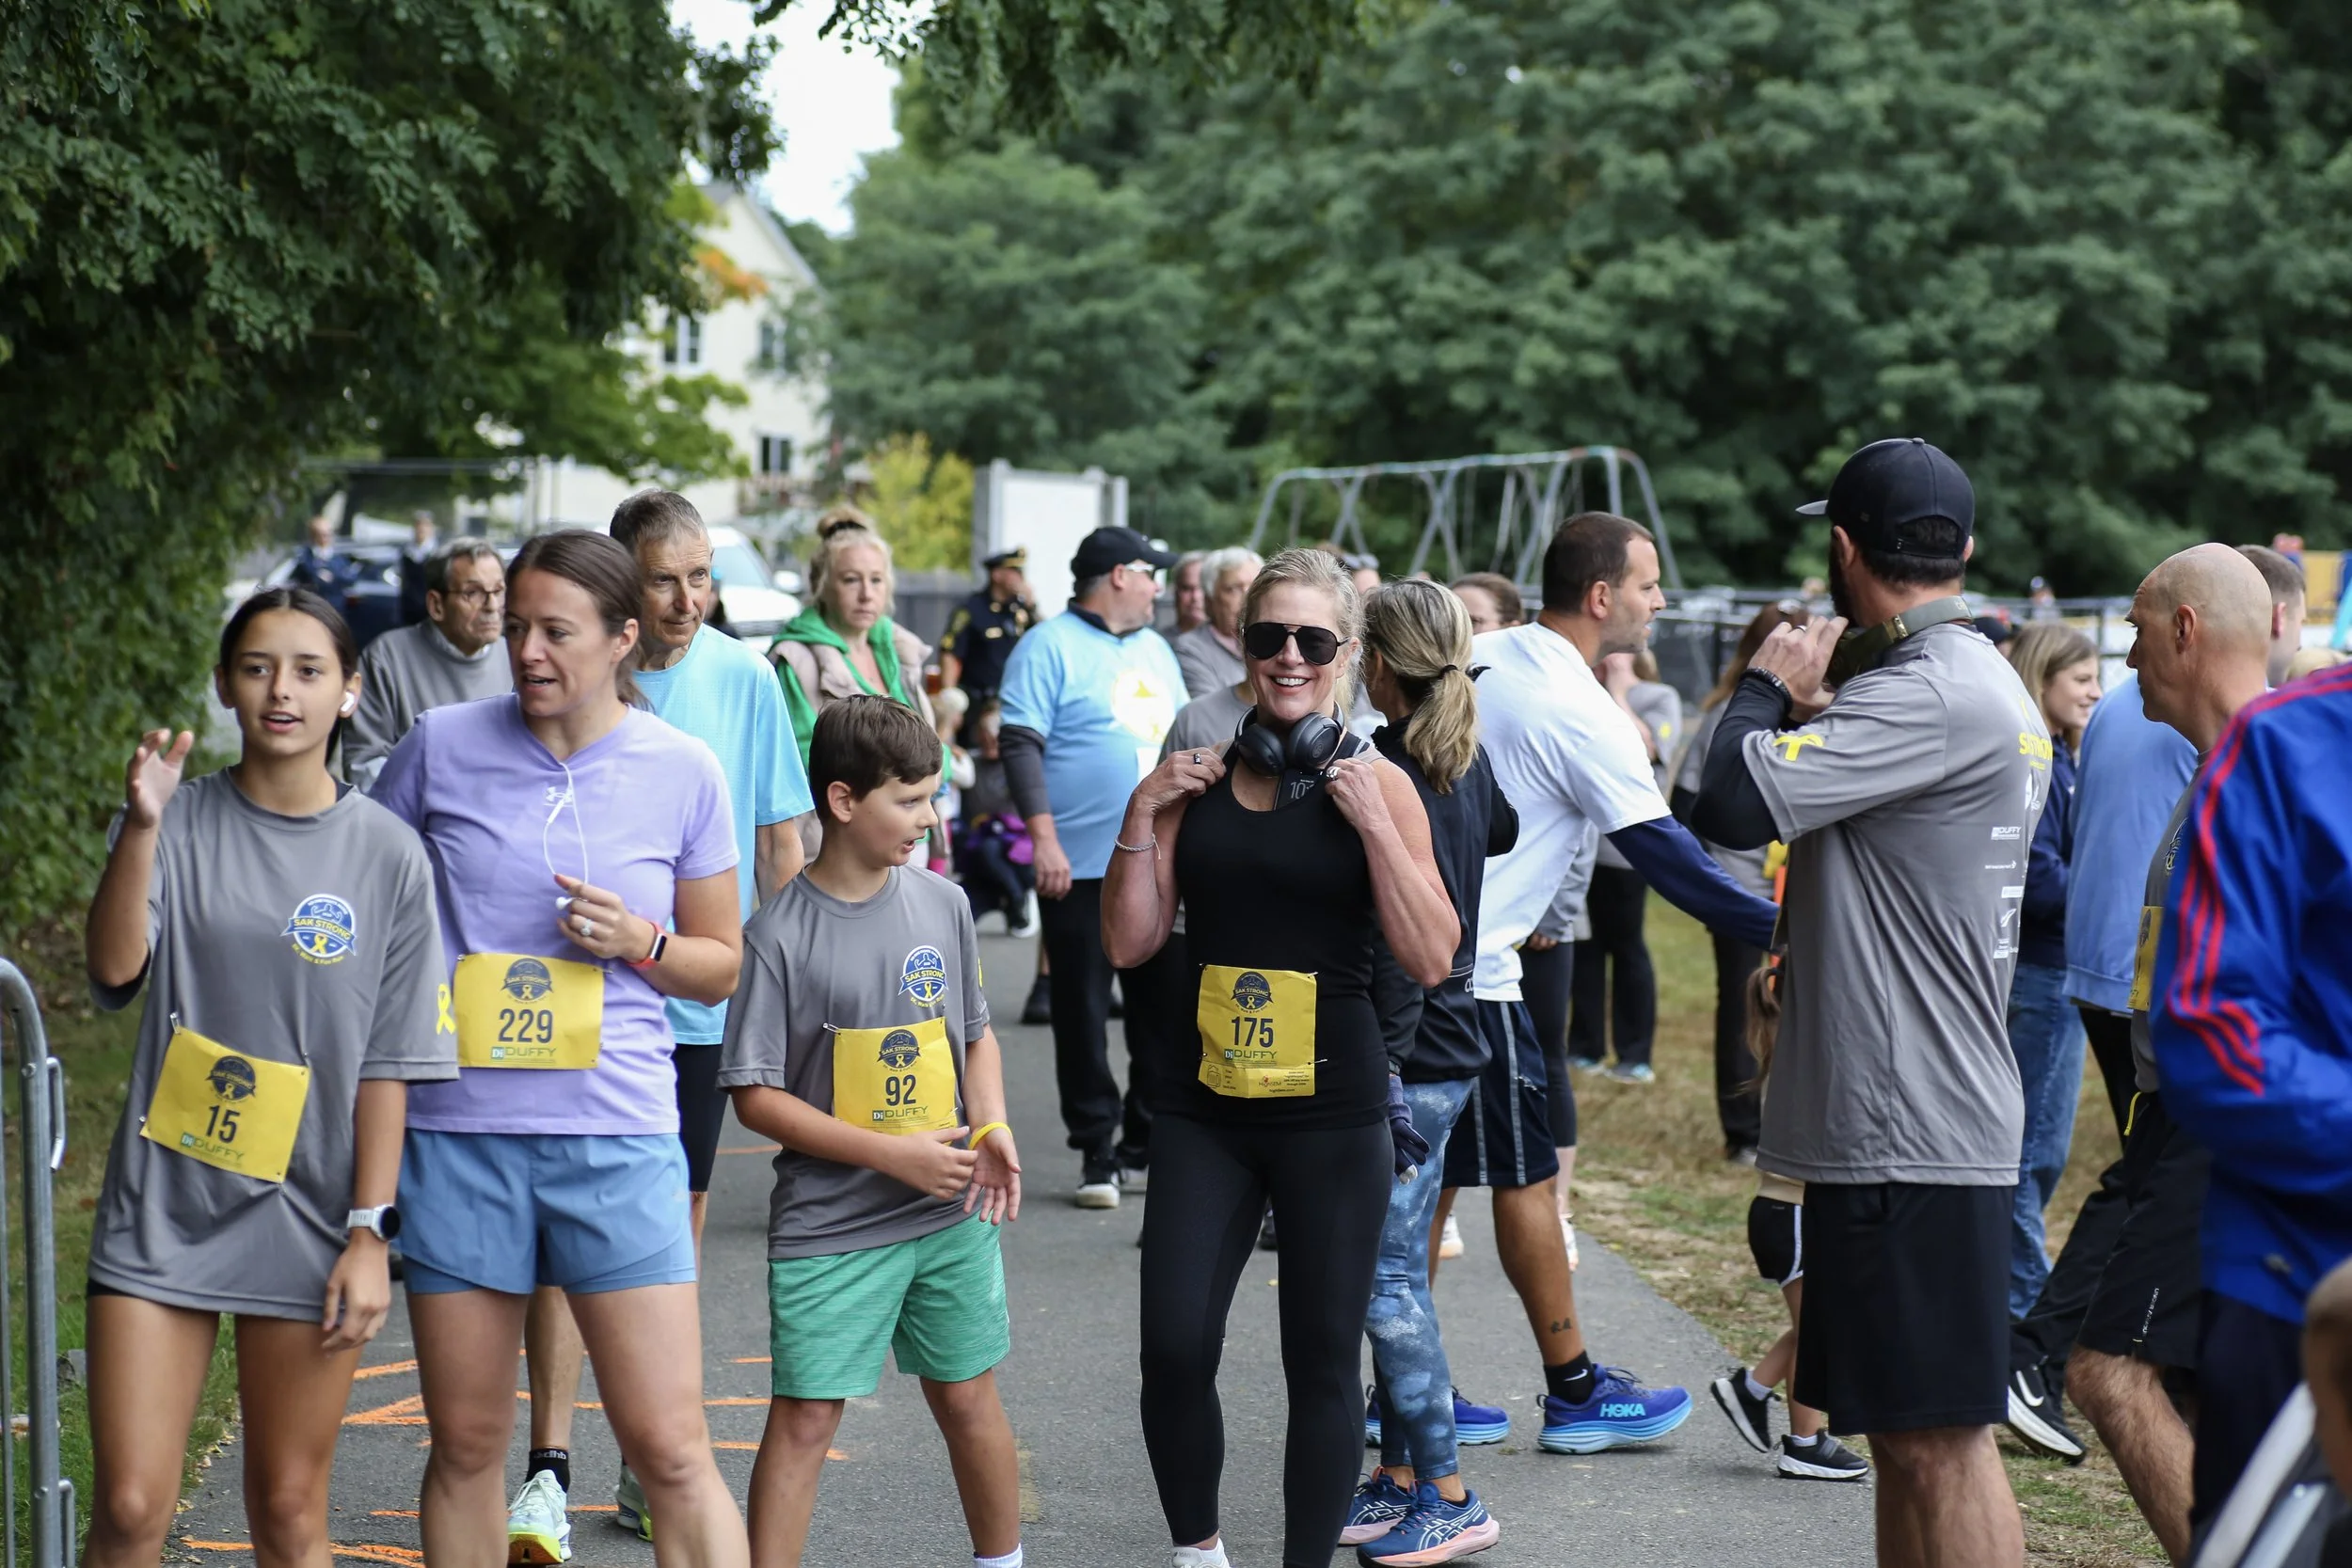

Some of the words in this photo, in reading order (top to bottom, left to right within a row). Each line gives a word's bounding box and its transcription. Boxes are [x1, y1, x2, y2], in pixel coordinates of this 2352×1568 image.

[294, 918, 314, 927] SAK
[315, 920, 351, 941] STRONG
[904, 972, 921, 982] SAK
[921, 970, 944, 978] STRONG
[1246, 988, 1269, 996] STRONG
[499, 1008, 552, 1043] 229
[1231, 1016, 1274, 1048] 175
[505, 1047, 557, 1057] DUFFY
[1233, 1049, 1277, 1059] DUFFY
[885, 1074, 916, 1106] 92
[884, 1106, 929, 1118] DUFFY
[206, 1105, 241, 1144] 15
[194, 1138, 246, 1161] DUFFY
[1599, 1403, 1645, 1418] HOKA
